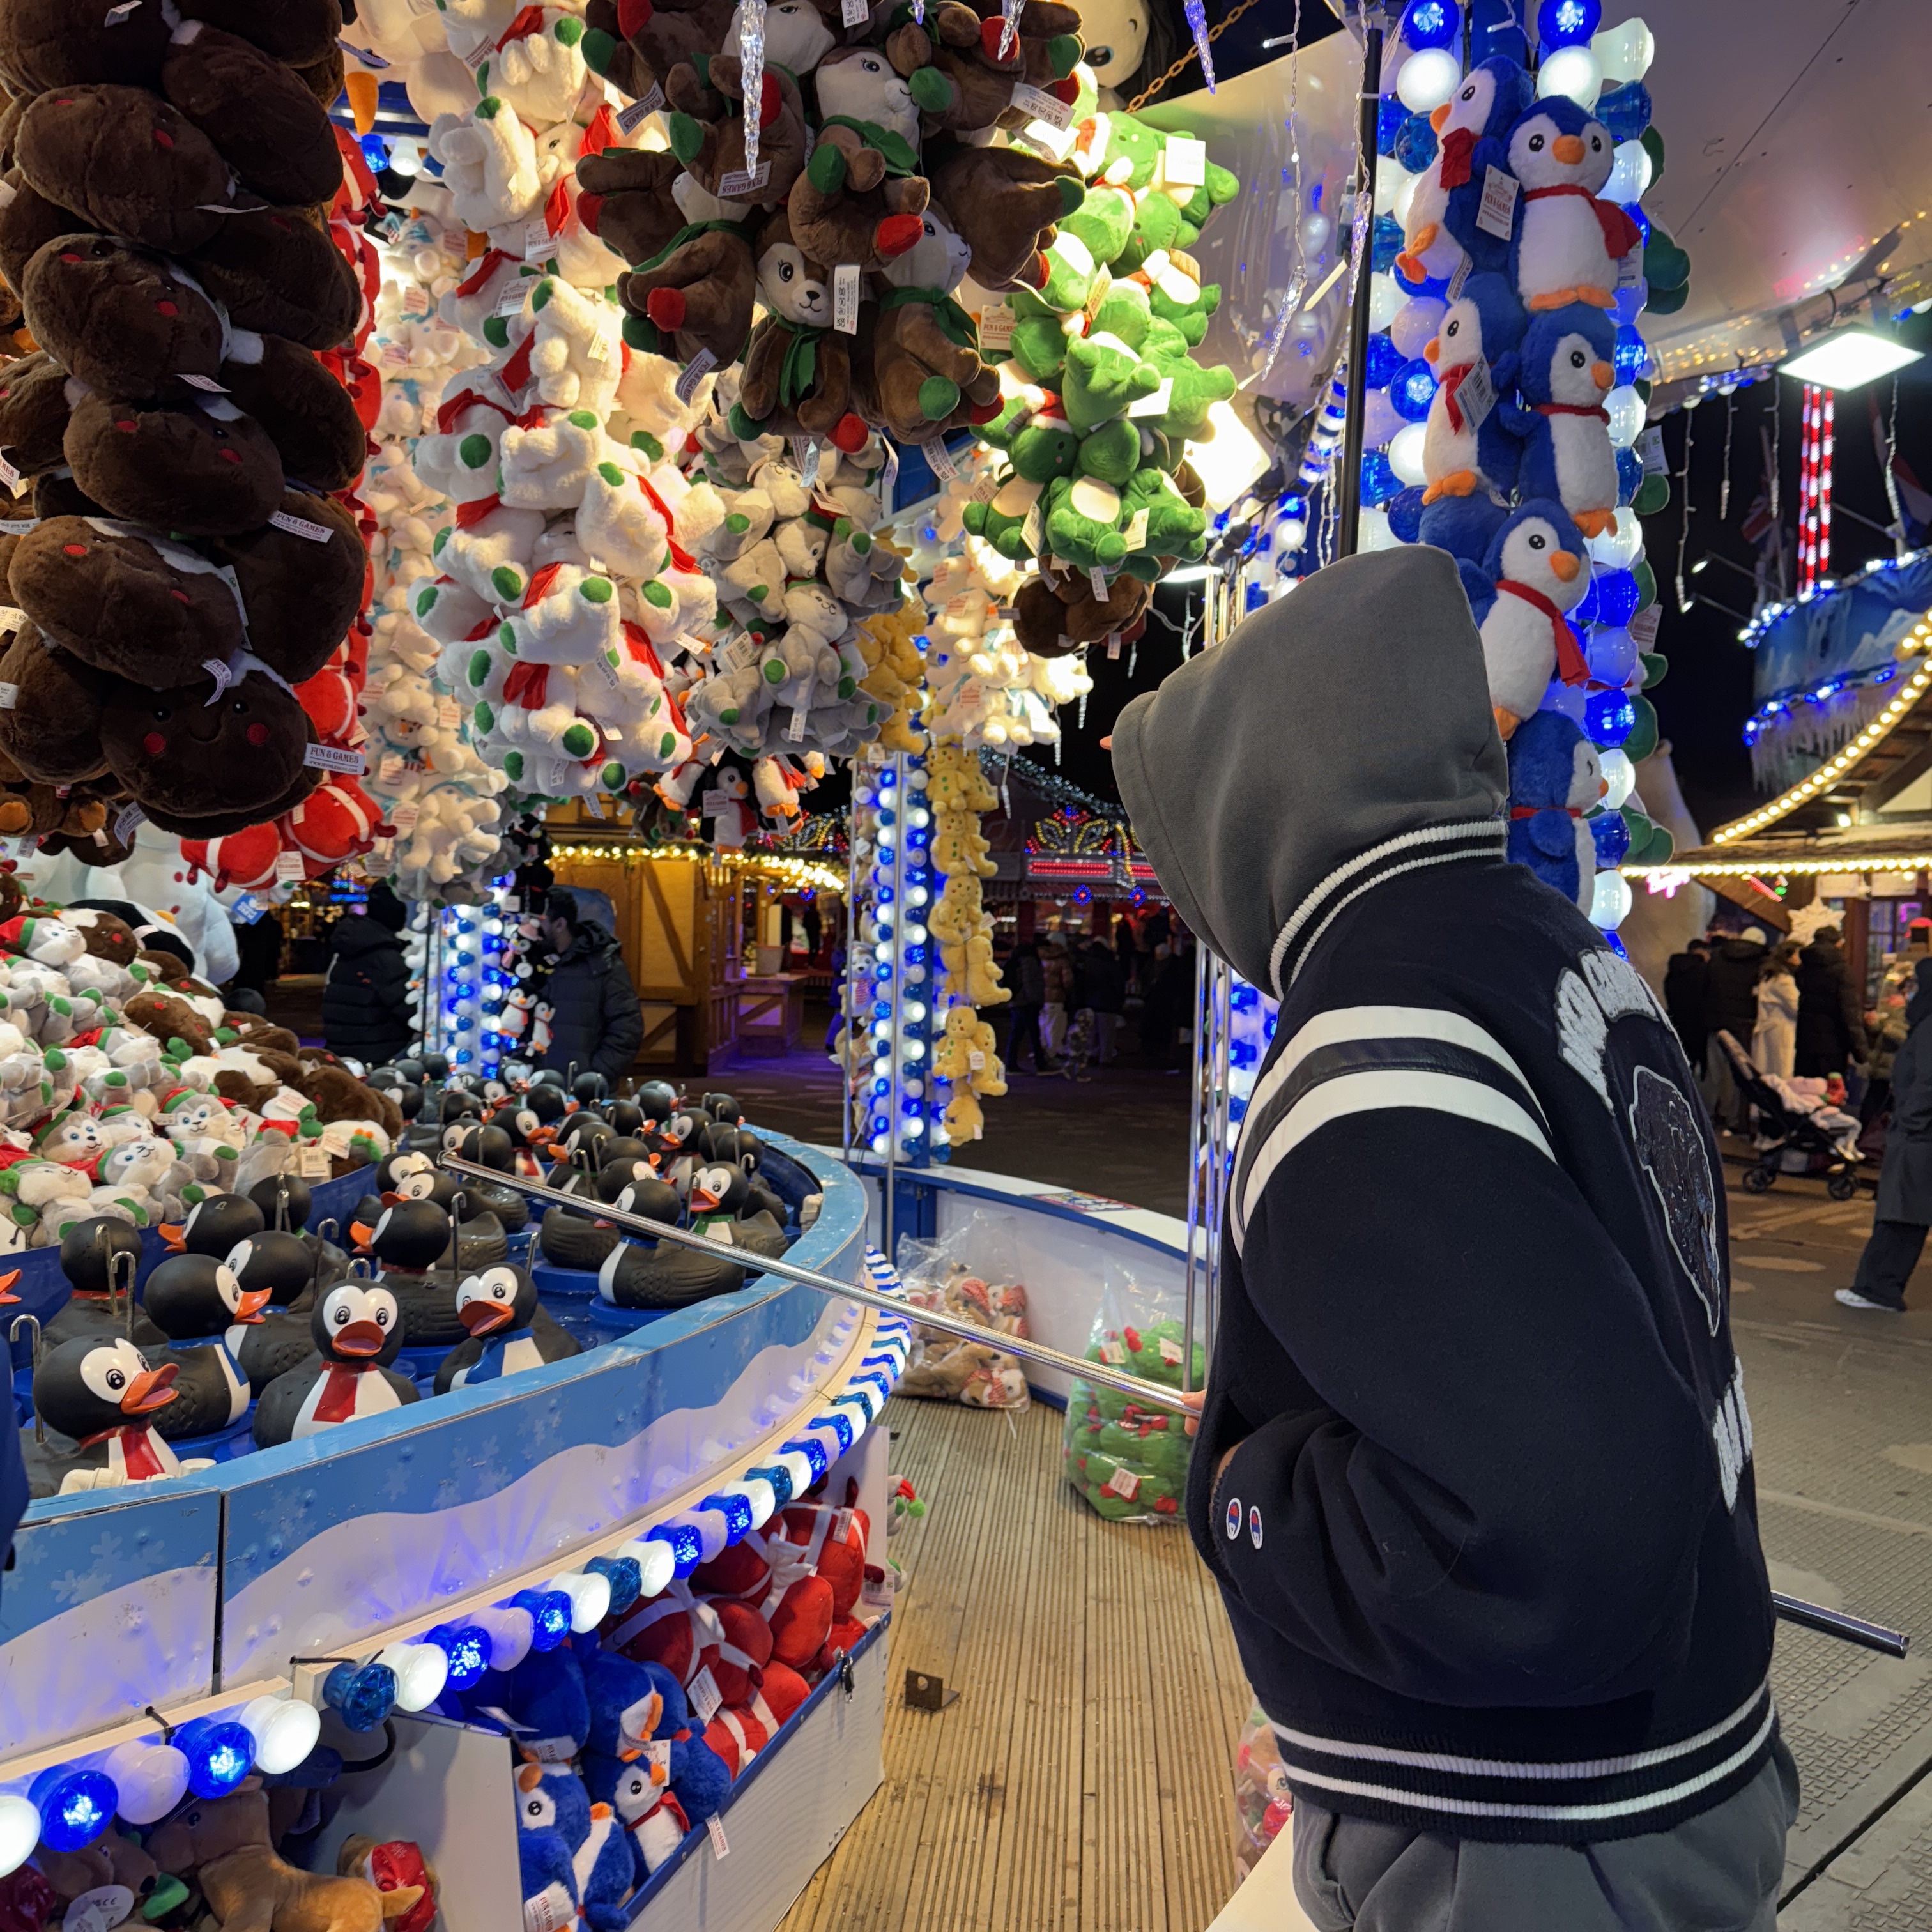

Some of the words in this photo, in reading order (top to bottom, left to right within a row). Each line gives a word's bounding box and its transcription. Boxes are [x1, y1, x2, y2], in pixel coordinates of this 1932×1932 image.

[650, 96, 662, 109] FUN
[624, 109, 644, 130] GAMES
[722, 182, 746, 194] GAMES
[747, 181, 751, 189] &
[752, 176, 763, 188] FUN
[698, 360, 710, 374] FUN
[683, 378, 696, 401] GAMES
[0, 459, 15, 477] AMES
[277, 513, 292, 523] FUN
[298, 521, 326, 533] GAMES
[310, 747, 325, 757] FUN
[326, 750, 331, 758] &
[333, 751, 359, 763] GAMES
